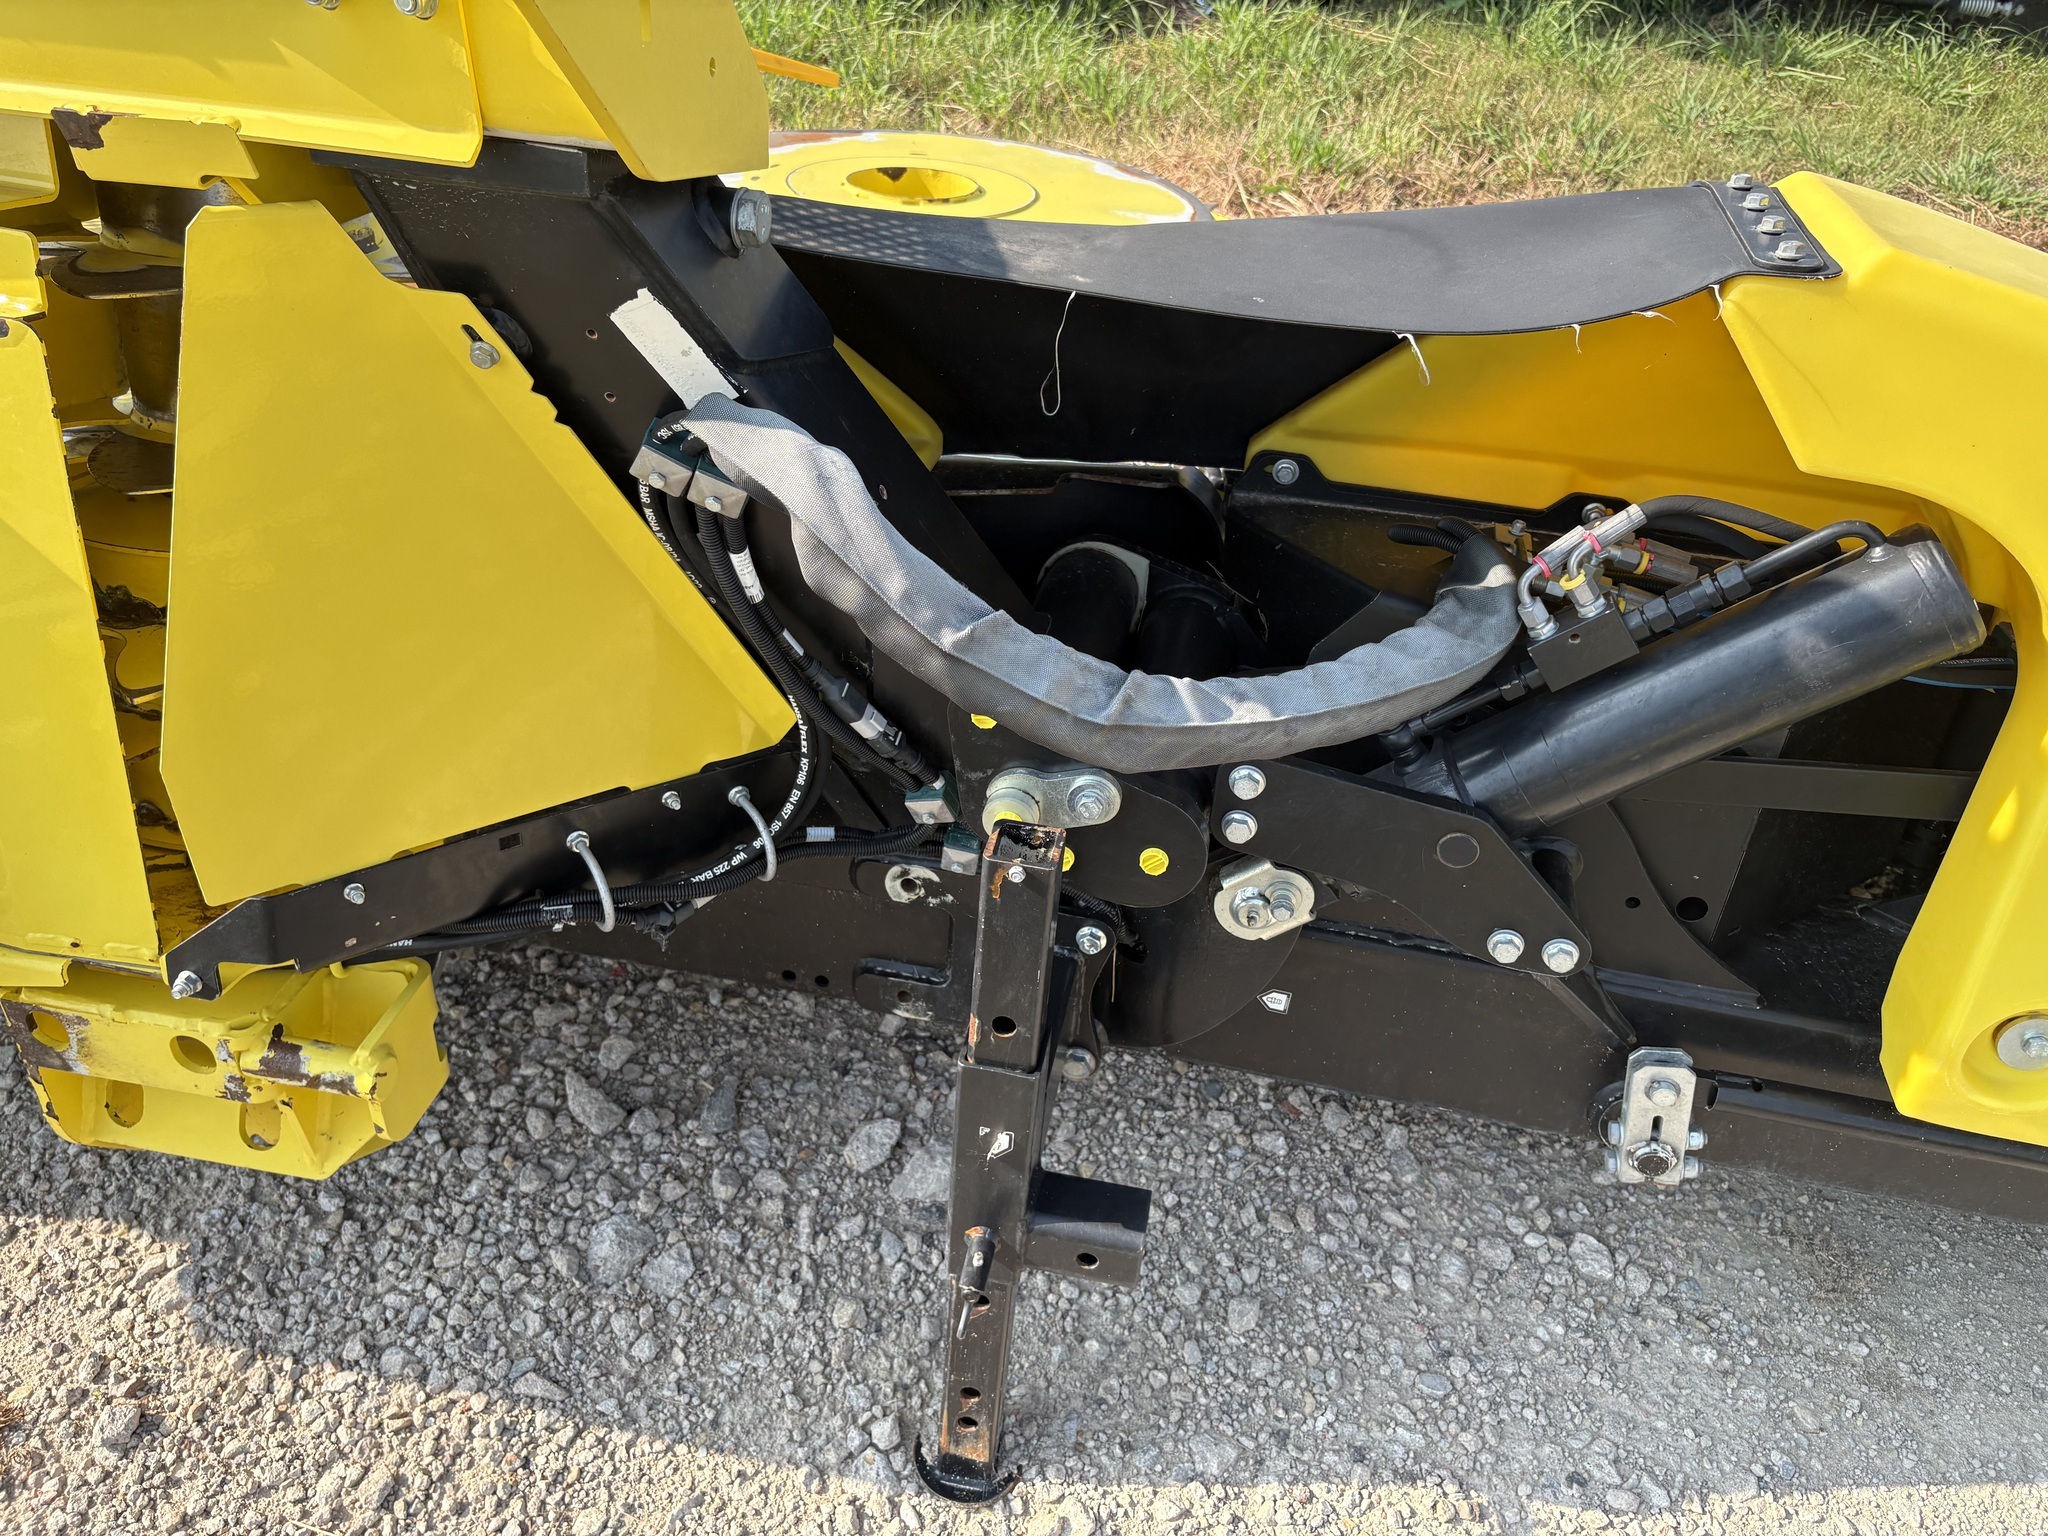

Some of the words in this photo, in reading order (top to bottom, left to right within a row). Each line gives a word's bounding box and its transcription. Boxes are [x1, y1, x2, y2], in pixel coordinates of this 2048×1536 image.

[639, 485, 650, 504] BAR
[643, 507, 660, 531] MSHA
[796, 757, 809, 786] KP106
[789, 788, 801, 805] EN
[781, 803, 795, 820] 857
[731, 850, 748, 866] WP
[714, 862, 731, 876] 225
